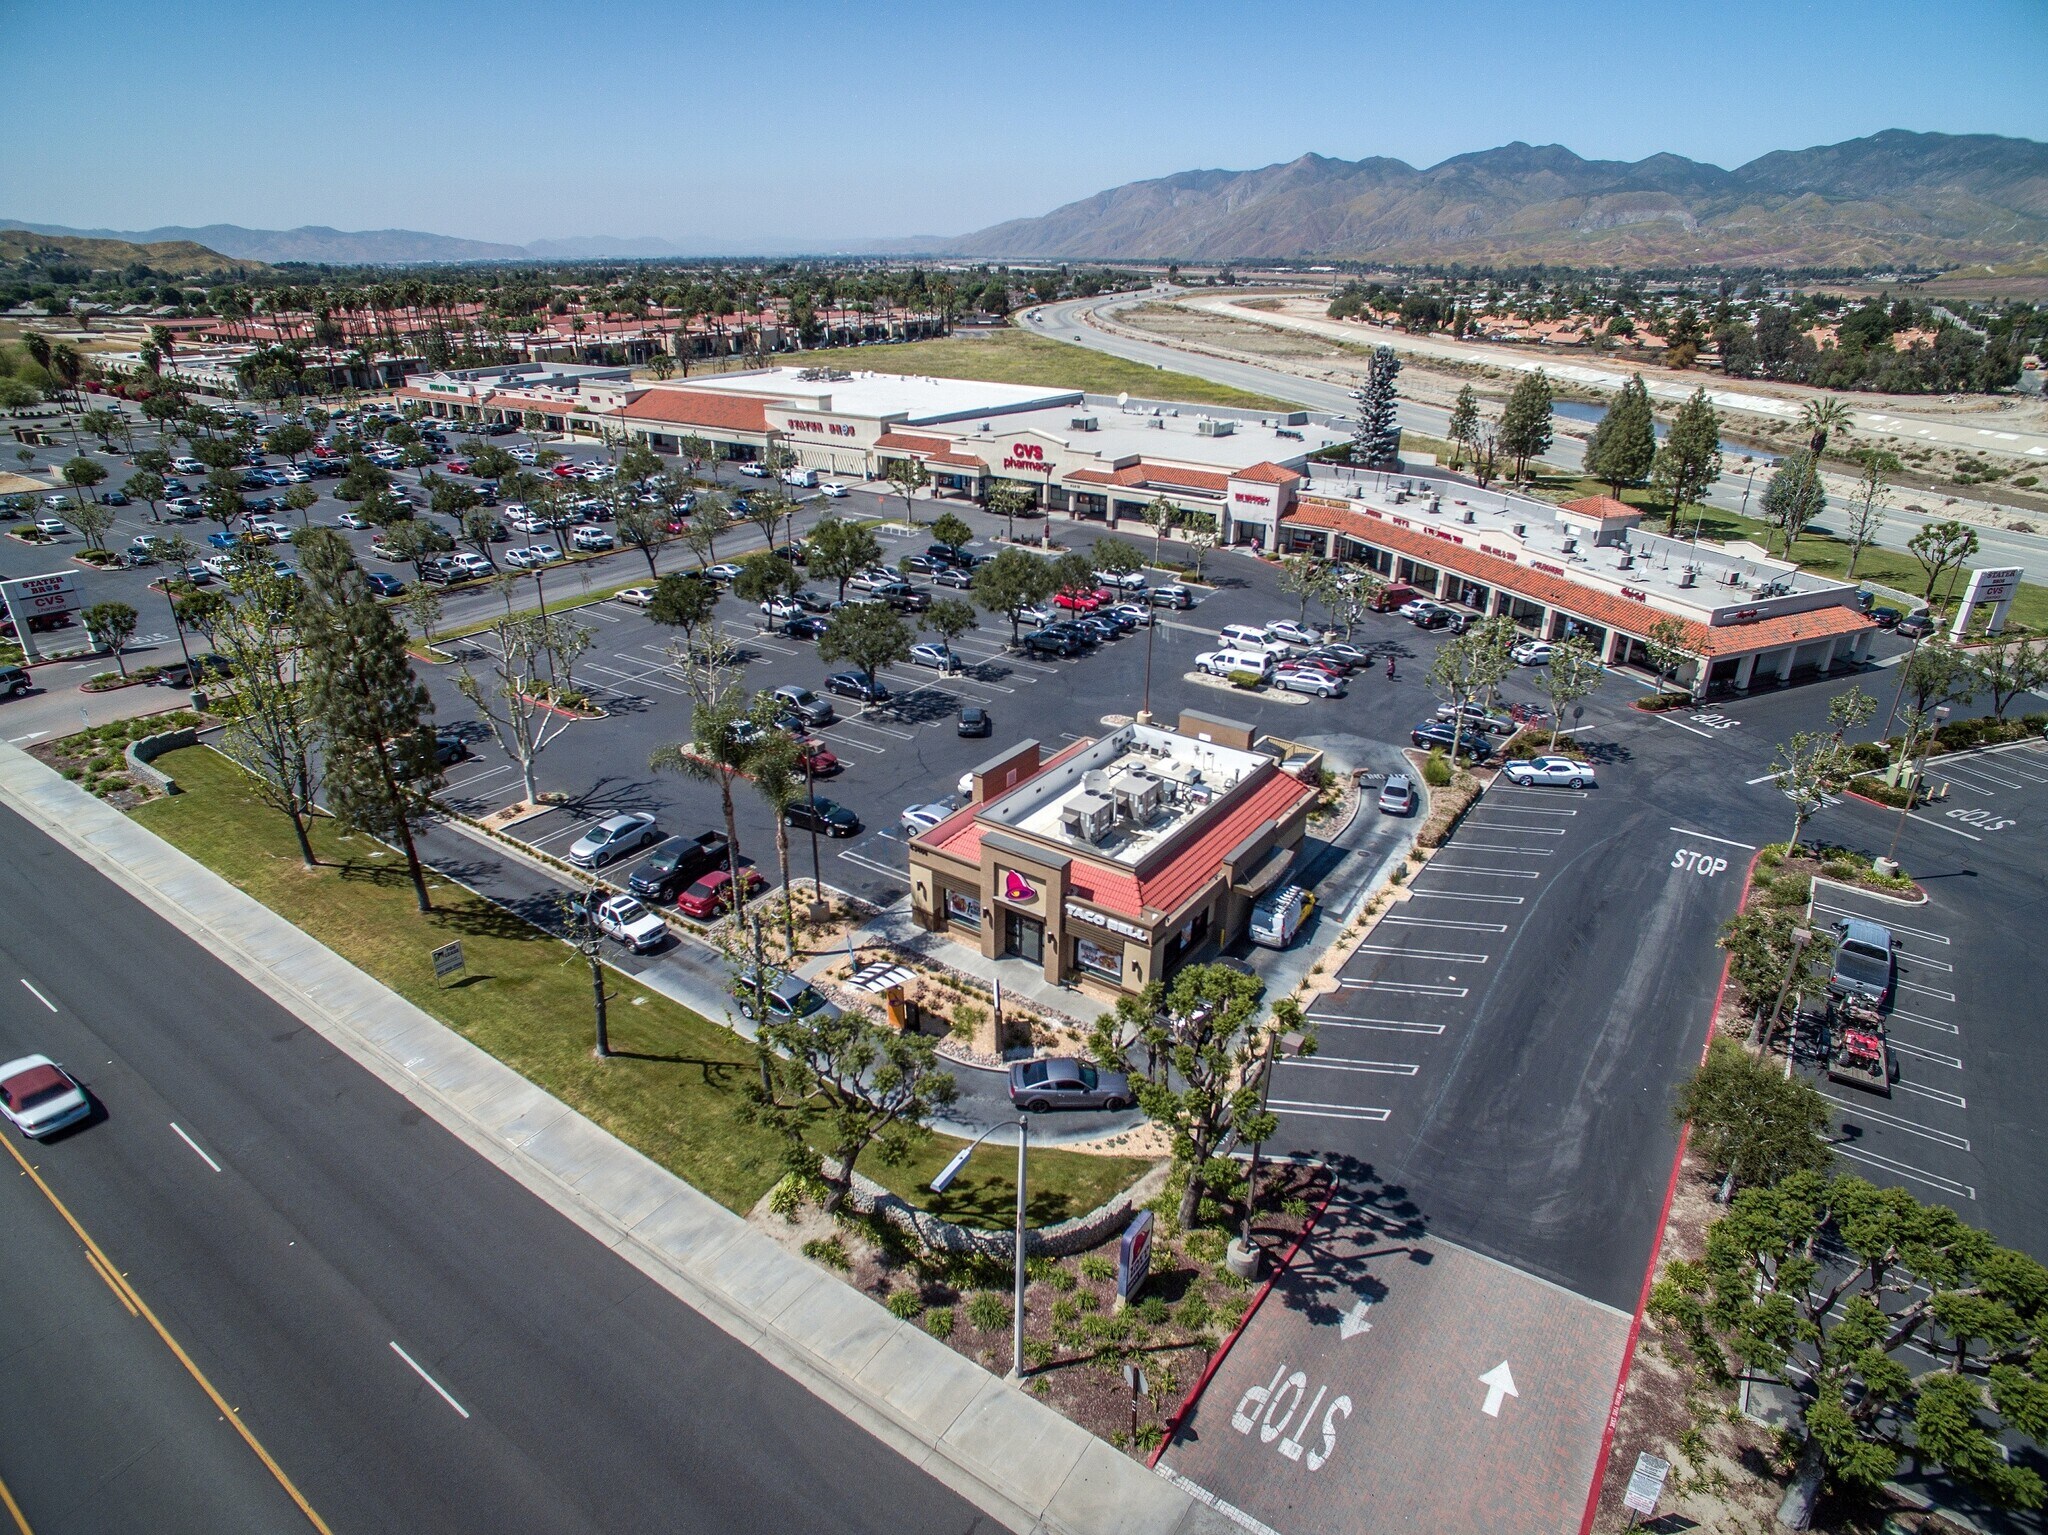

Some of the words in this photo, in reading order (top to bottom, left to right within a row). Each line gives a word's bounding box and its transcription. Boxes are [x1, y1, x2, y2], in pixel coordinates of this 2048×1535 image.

[1013, 443, 1043, 460] CVS
[1003, 457, 1053, 476] pharmacy
[22, 576, 64, 589] STATER
[1987, 587, 2004, 595] CVS
[34, 595, 65, 607] CVS
[1690, 713, 1741, 728] STOP
[1945, 808, 2017, 831] STOP
[1670, 848, 1728, 877] STOP
[1064, 902, 1106, 926] TACO
[1106, 918, 1148, 942] BELL
[1231, 1364, 1353, 1472] STOP
